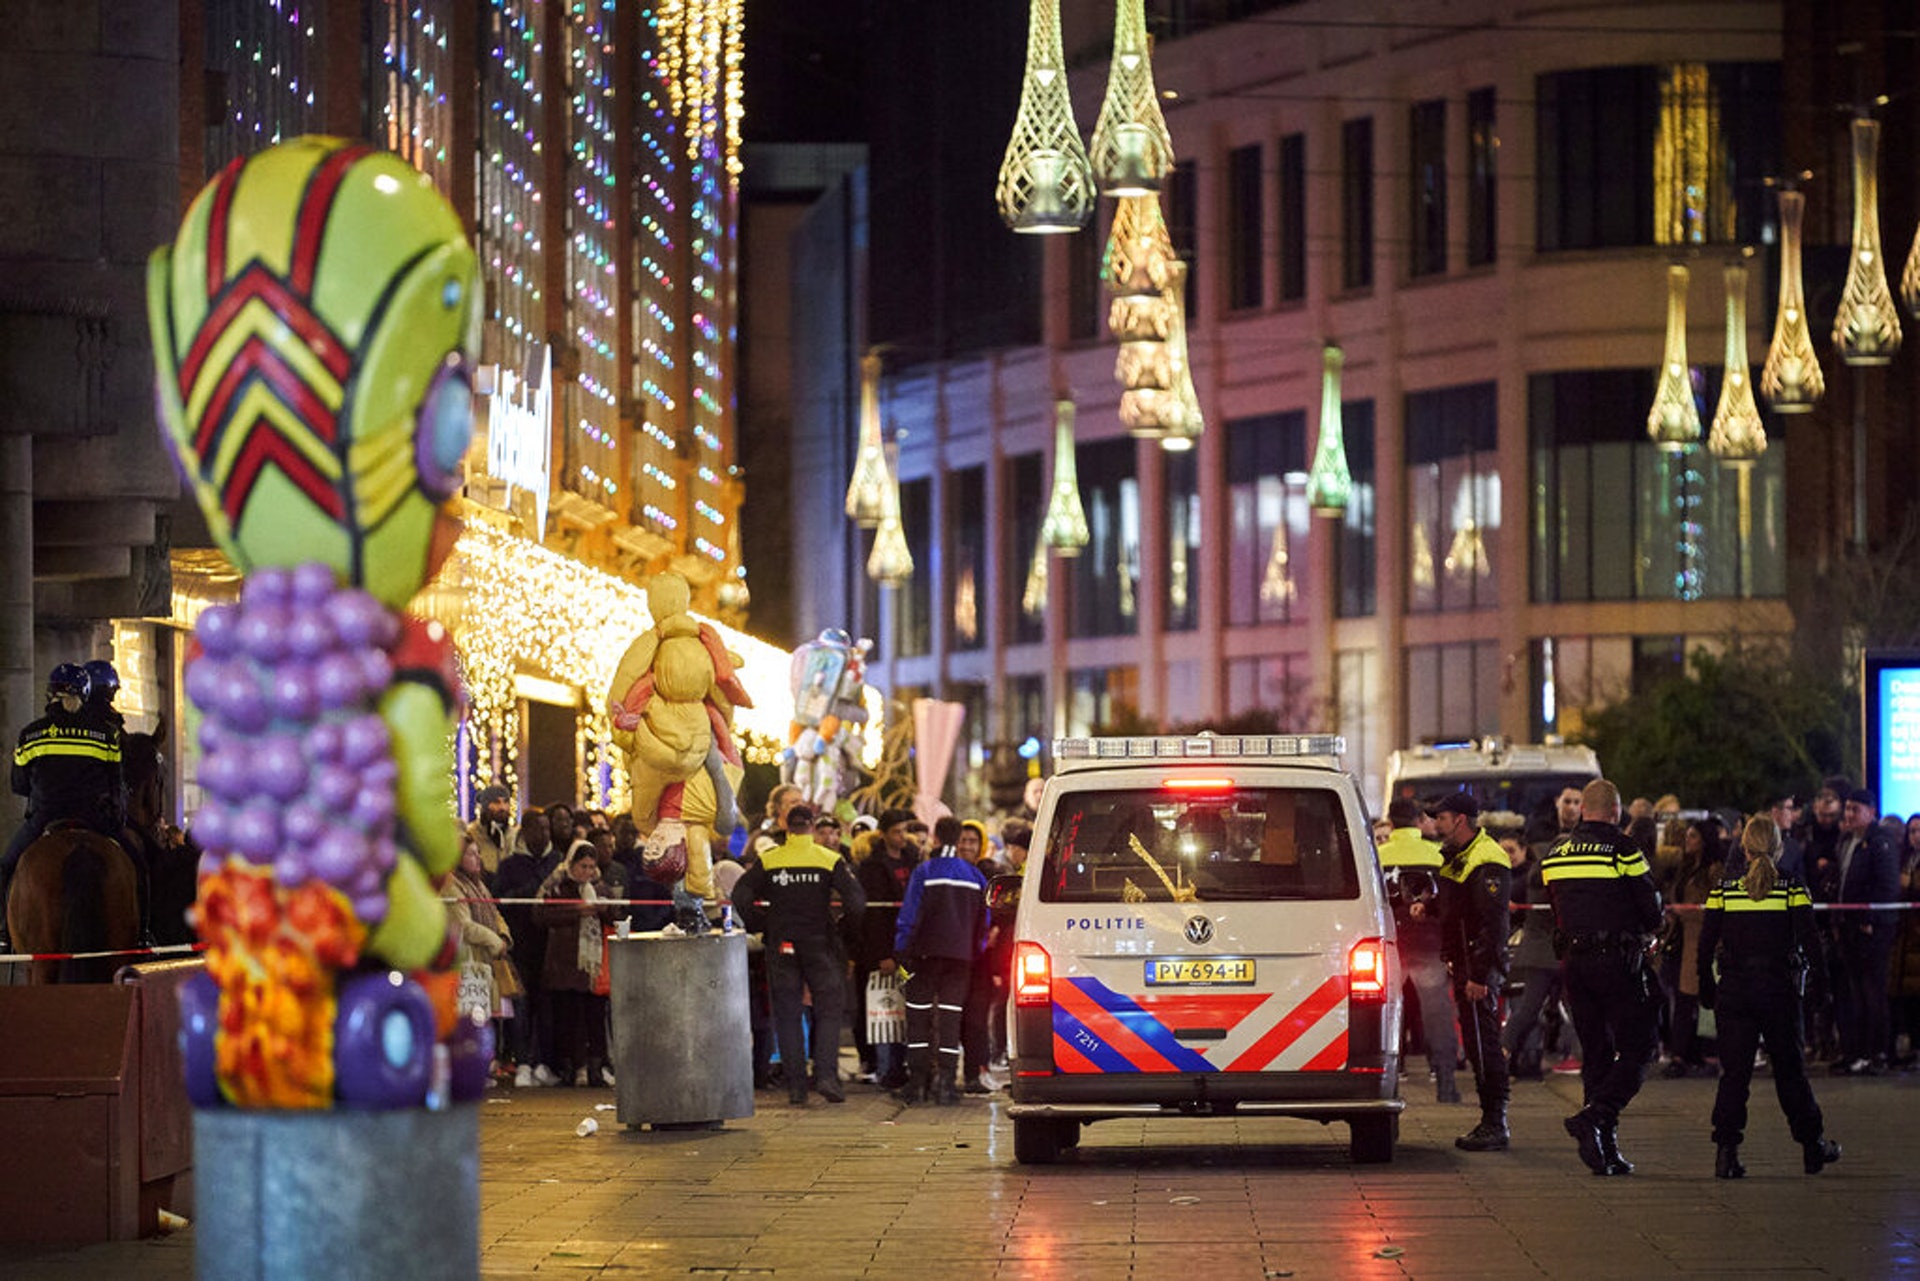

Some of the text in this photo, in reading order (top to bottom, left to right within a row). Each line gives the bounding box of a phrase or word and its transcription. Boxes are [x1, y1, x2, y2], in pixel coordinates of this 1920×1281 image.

[1066, 918, 1145, 930] POLITIE
[1159, 963, 1247, 979] PV-694-H
[1074, 1029, 1099, 1051] 7211
